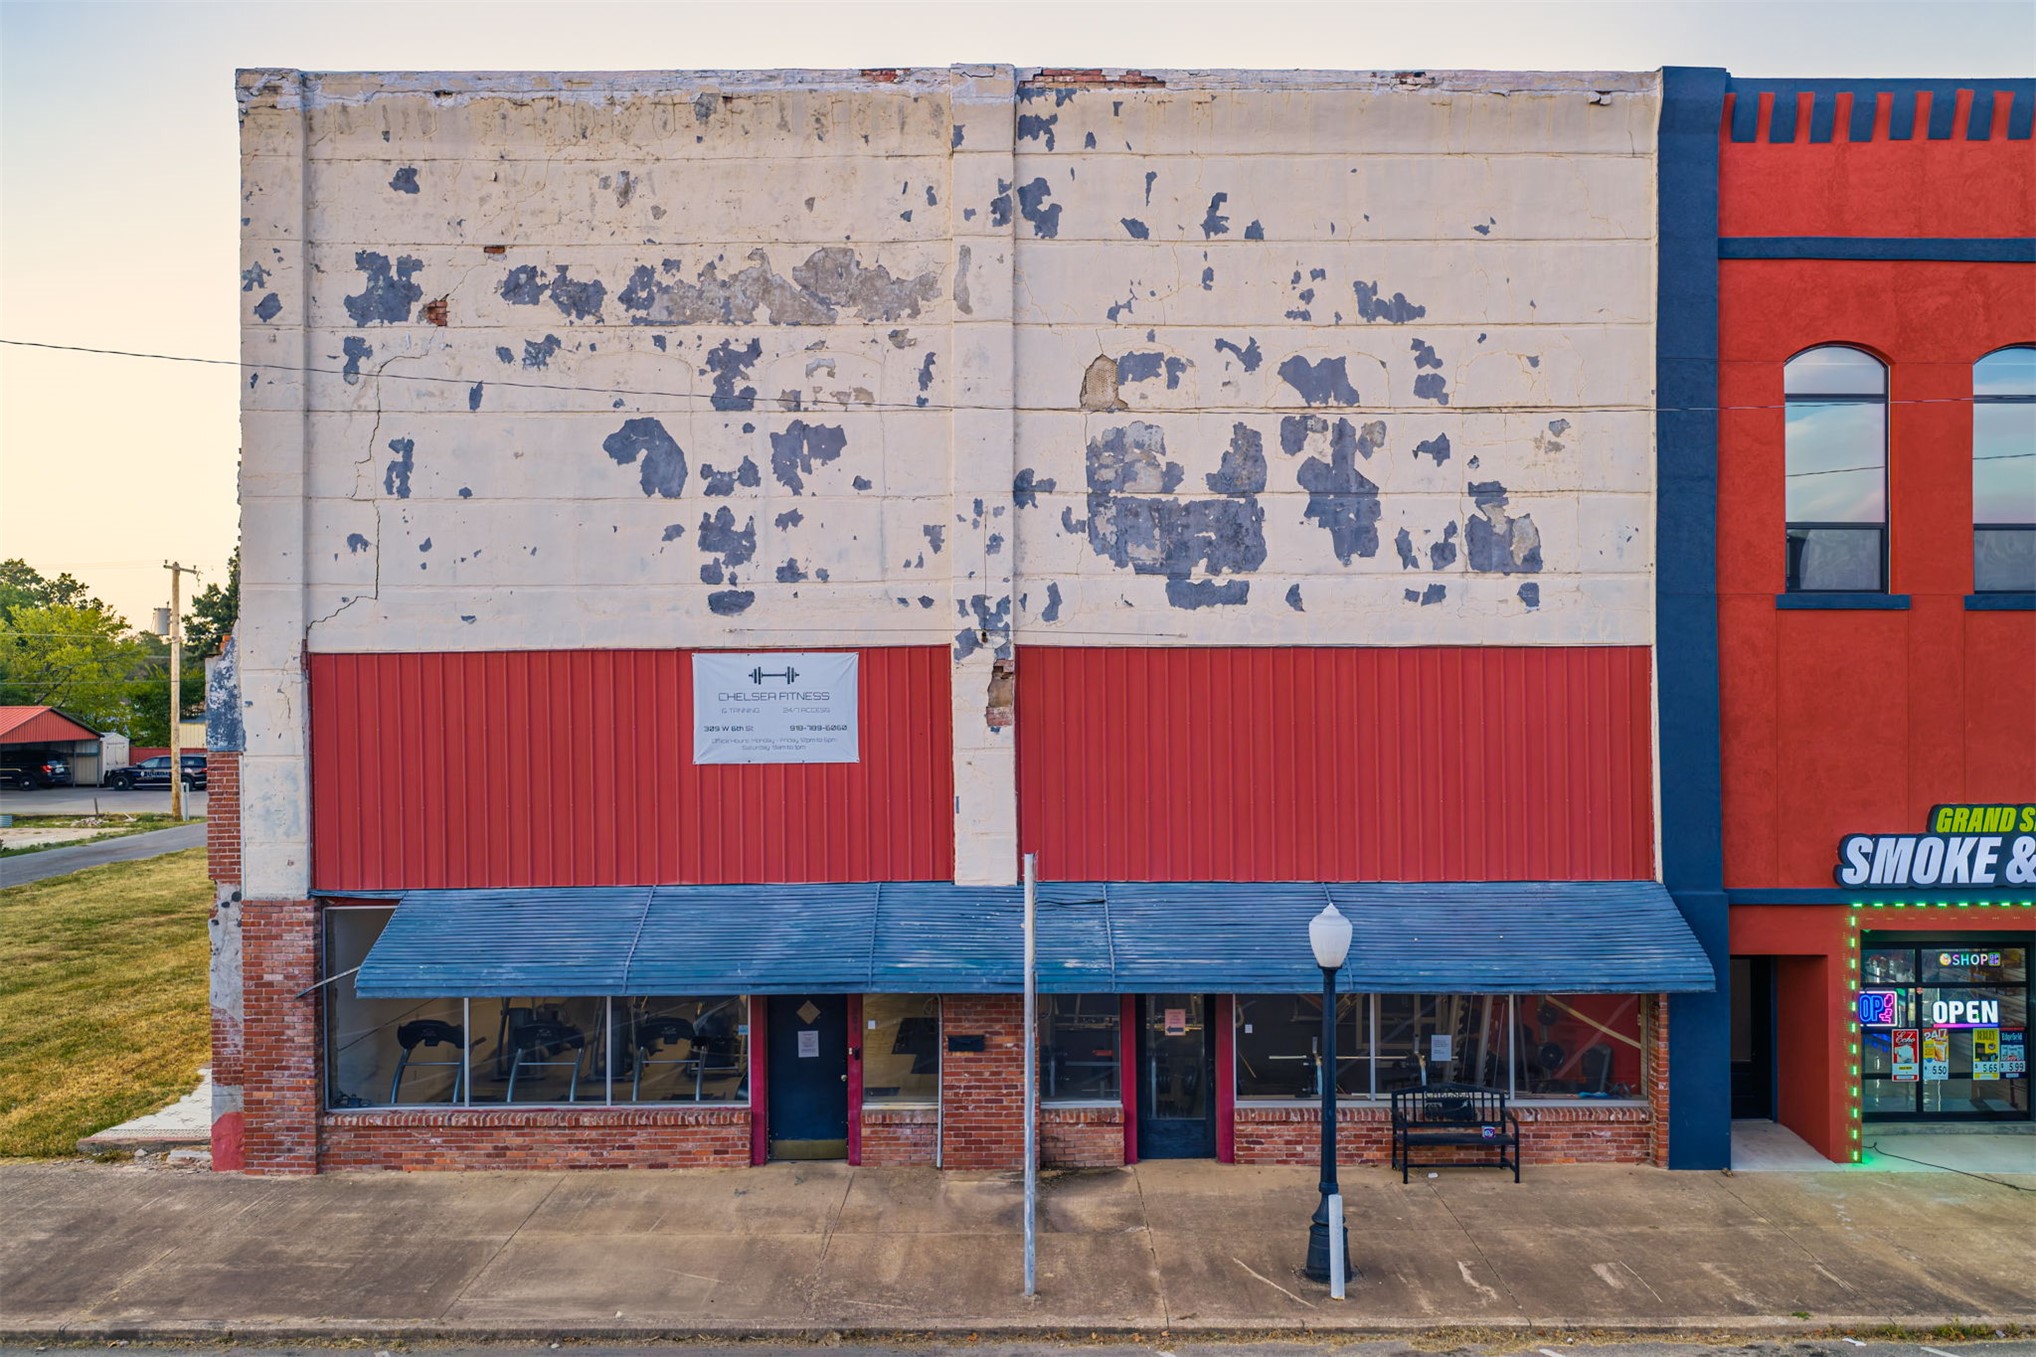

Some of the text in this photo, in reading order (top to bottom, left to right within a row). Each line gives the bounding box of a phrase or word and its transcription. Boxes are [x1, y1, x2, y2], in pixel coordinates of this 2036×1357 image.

[718, 691, 831, 702] CHELSEA FITNESS
[1936, 807, 2036, 833] GRAND S
[1842, 835, 2036, 884] SMOKE &
[1952, 953, 1988, 966] SHOP
[1932, 1000, 1999, 1024] OPEN
[1895, 1031, 1916, 1043] Echo
[2009, 1062, 2024, 1072] 5.99
